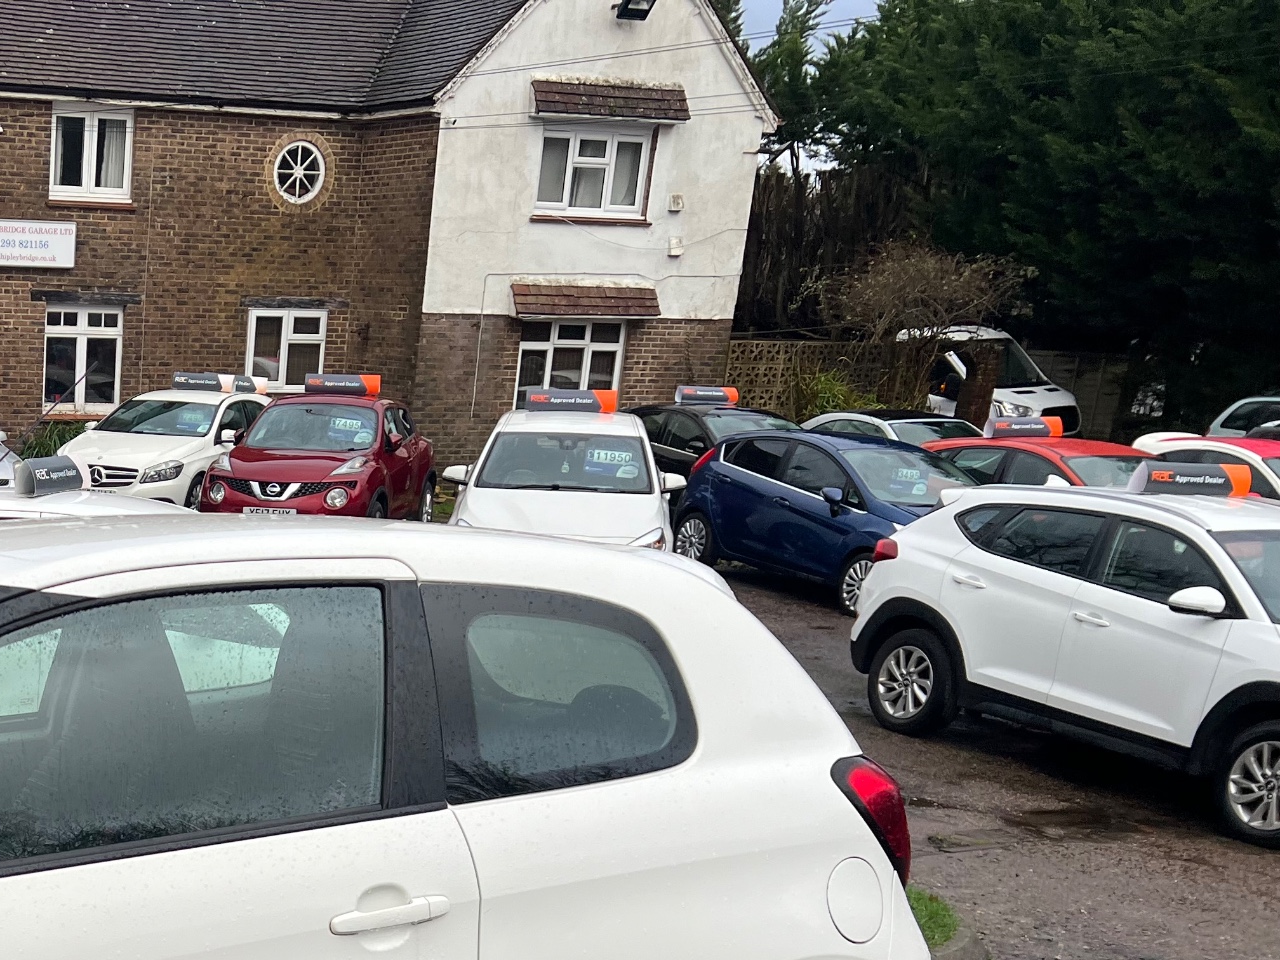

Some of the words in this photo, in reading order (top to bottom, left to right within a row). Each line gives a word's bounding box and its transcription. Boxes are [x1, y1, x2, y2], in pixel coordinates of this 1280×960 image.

[28, 227, 58, 235] GARAGE
[60, 228, 74, 236] LTD
[18, 240, 49, 249] 821156
[1175, 475, 1204, 484] Approved
[1205, 475, 1226, 484] Dealer
